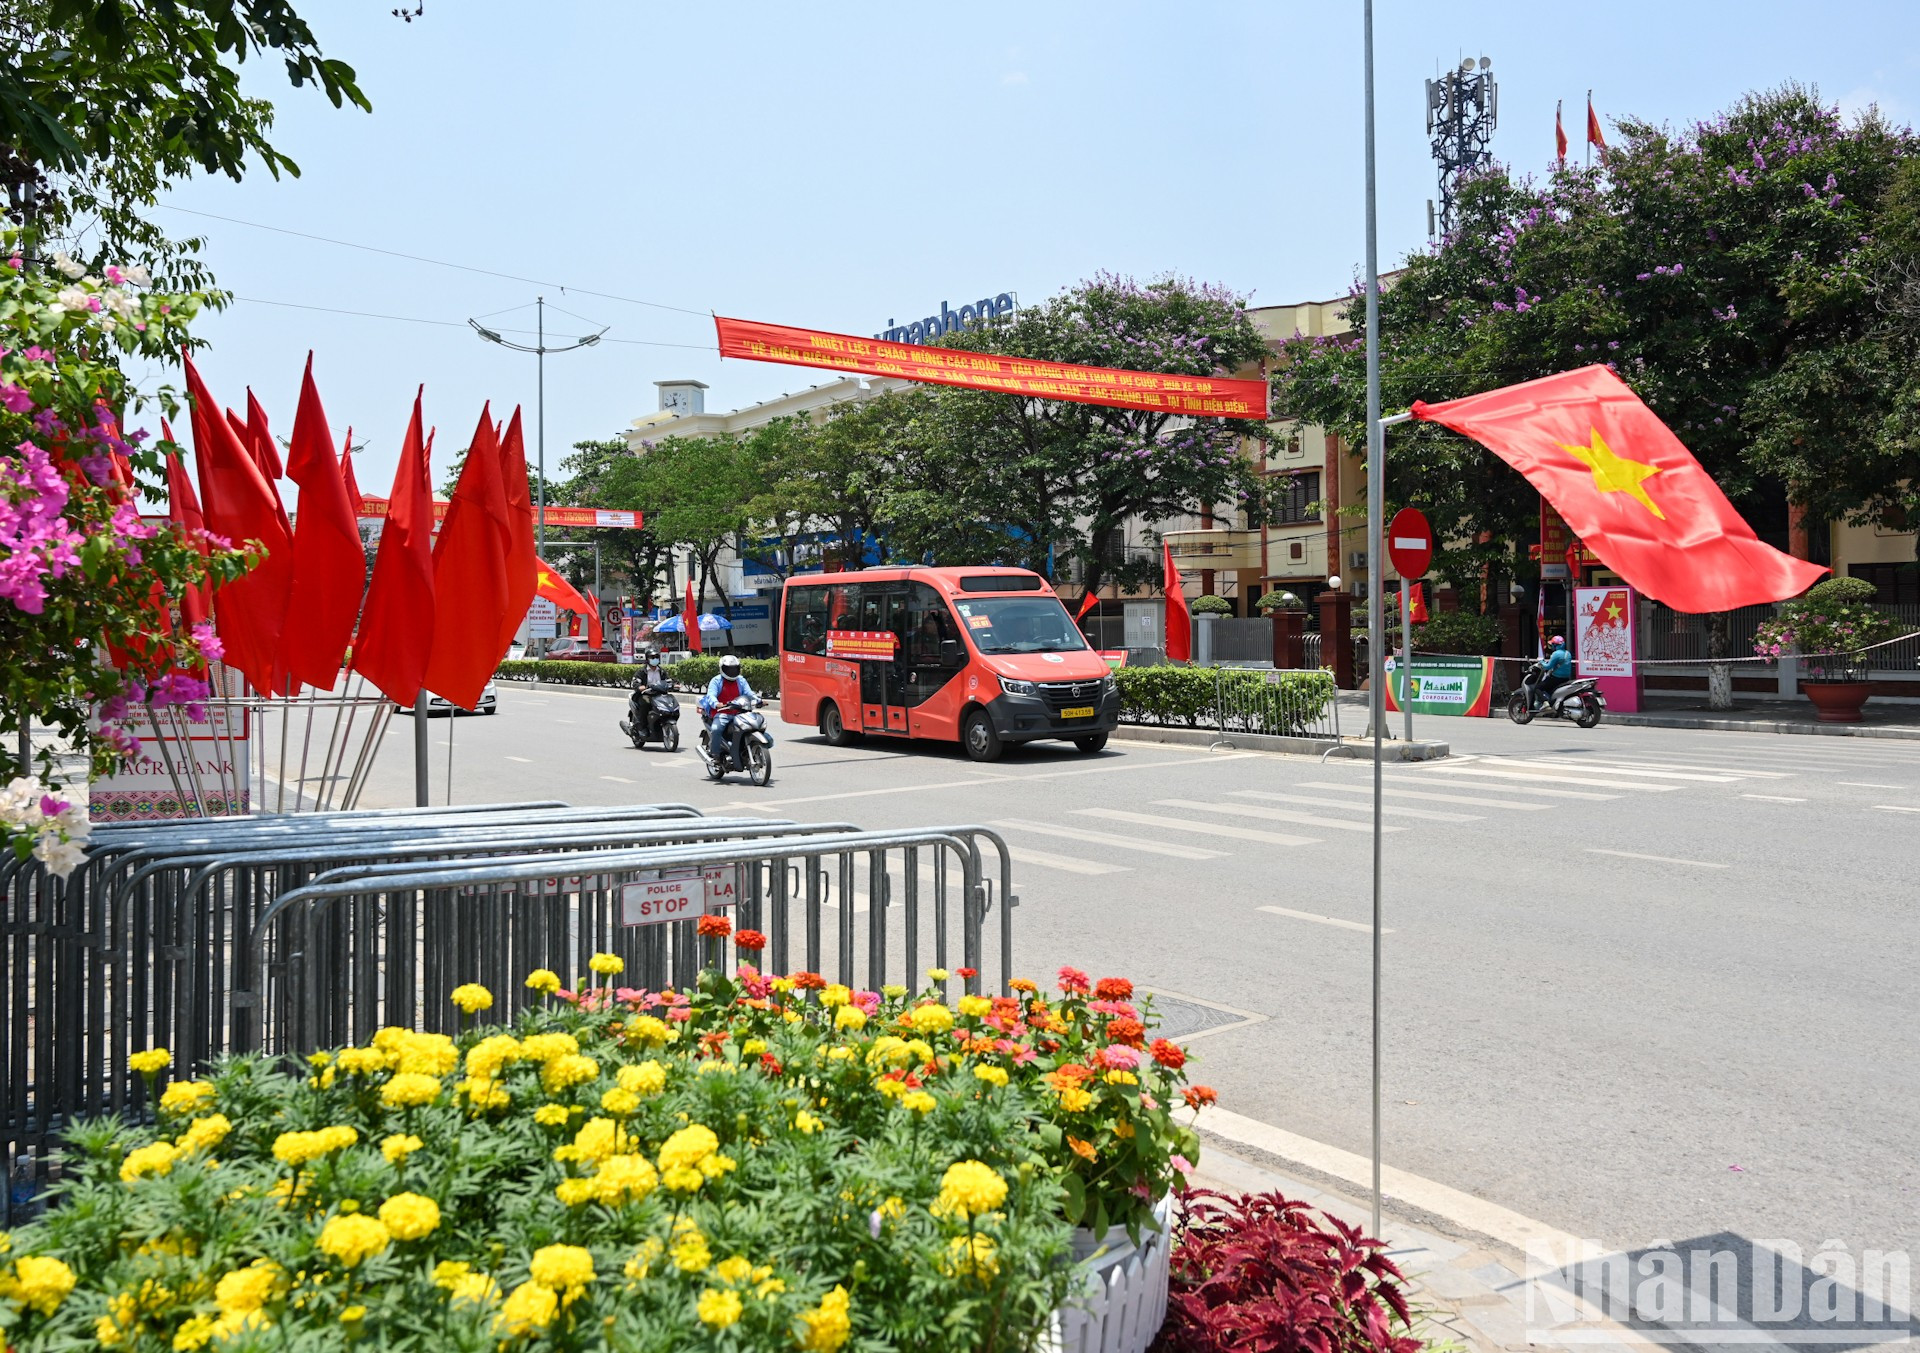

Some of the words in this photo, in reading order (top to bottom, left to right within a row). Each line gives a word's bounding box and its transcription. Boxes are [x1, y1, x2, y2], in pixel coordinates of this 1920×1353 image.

[874, 293, 1013, 345] inaphone
[810, 336, 845, 352] NHIỆT
[847, 341, 871, 356] LIỆT
[877, 344, 907, 361] CHÀO
[911, 348, 944, 366] MỪNG
[946, 355, 969, 368] CÁC
[970, 357, 1001, 373] ĐOÀN
[1011, 361, 1032, 377] VẬN
[1034, 364, 1063, 379] ĐỘNG
[1063, 367, 1087, 381] VIÊN
[1088, 371, 1117, 384] THAM
[1134, 376, 1158, 389] CUỘC
[119, 760, 233, 777] AGRBANK
[647, 883, 682, 895] POLICE
[641, 897, 689, 916] STOP
